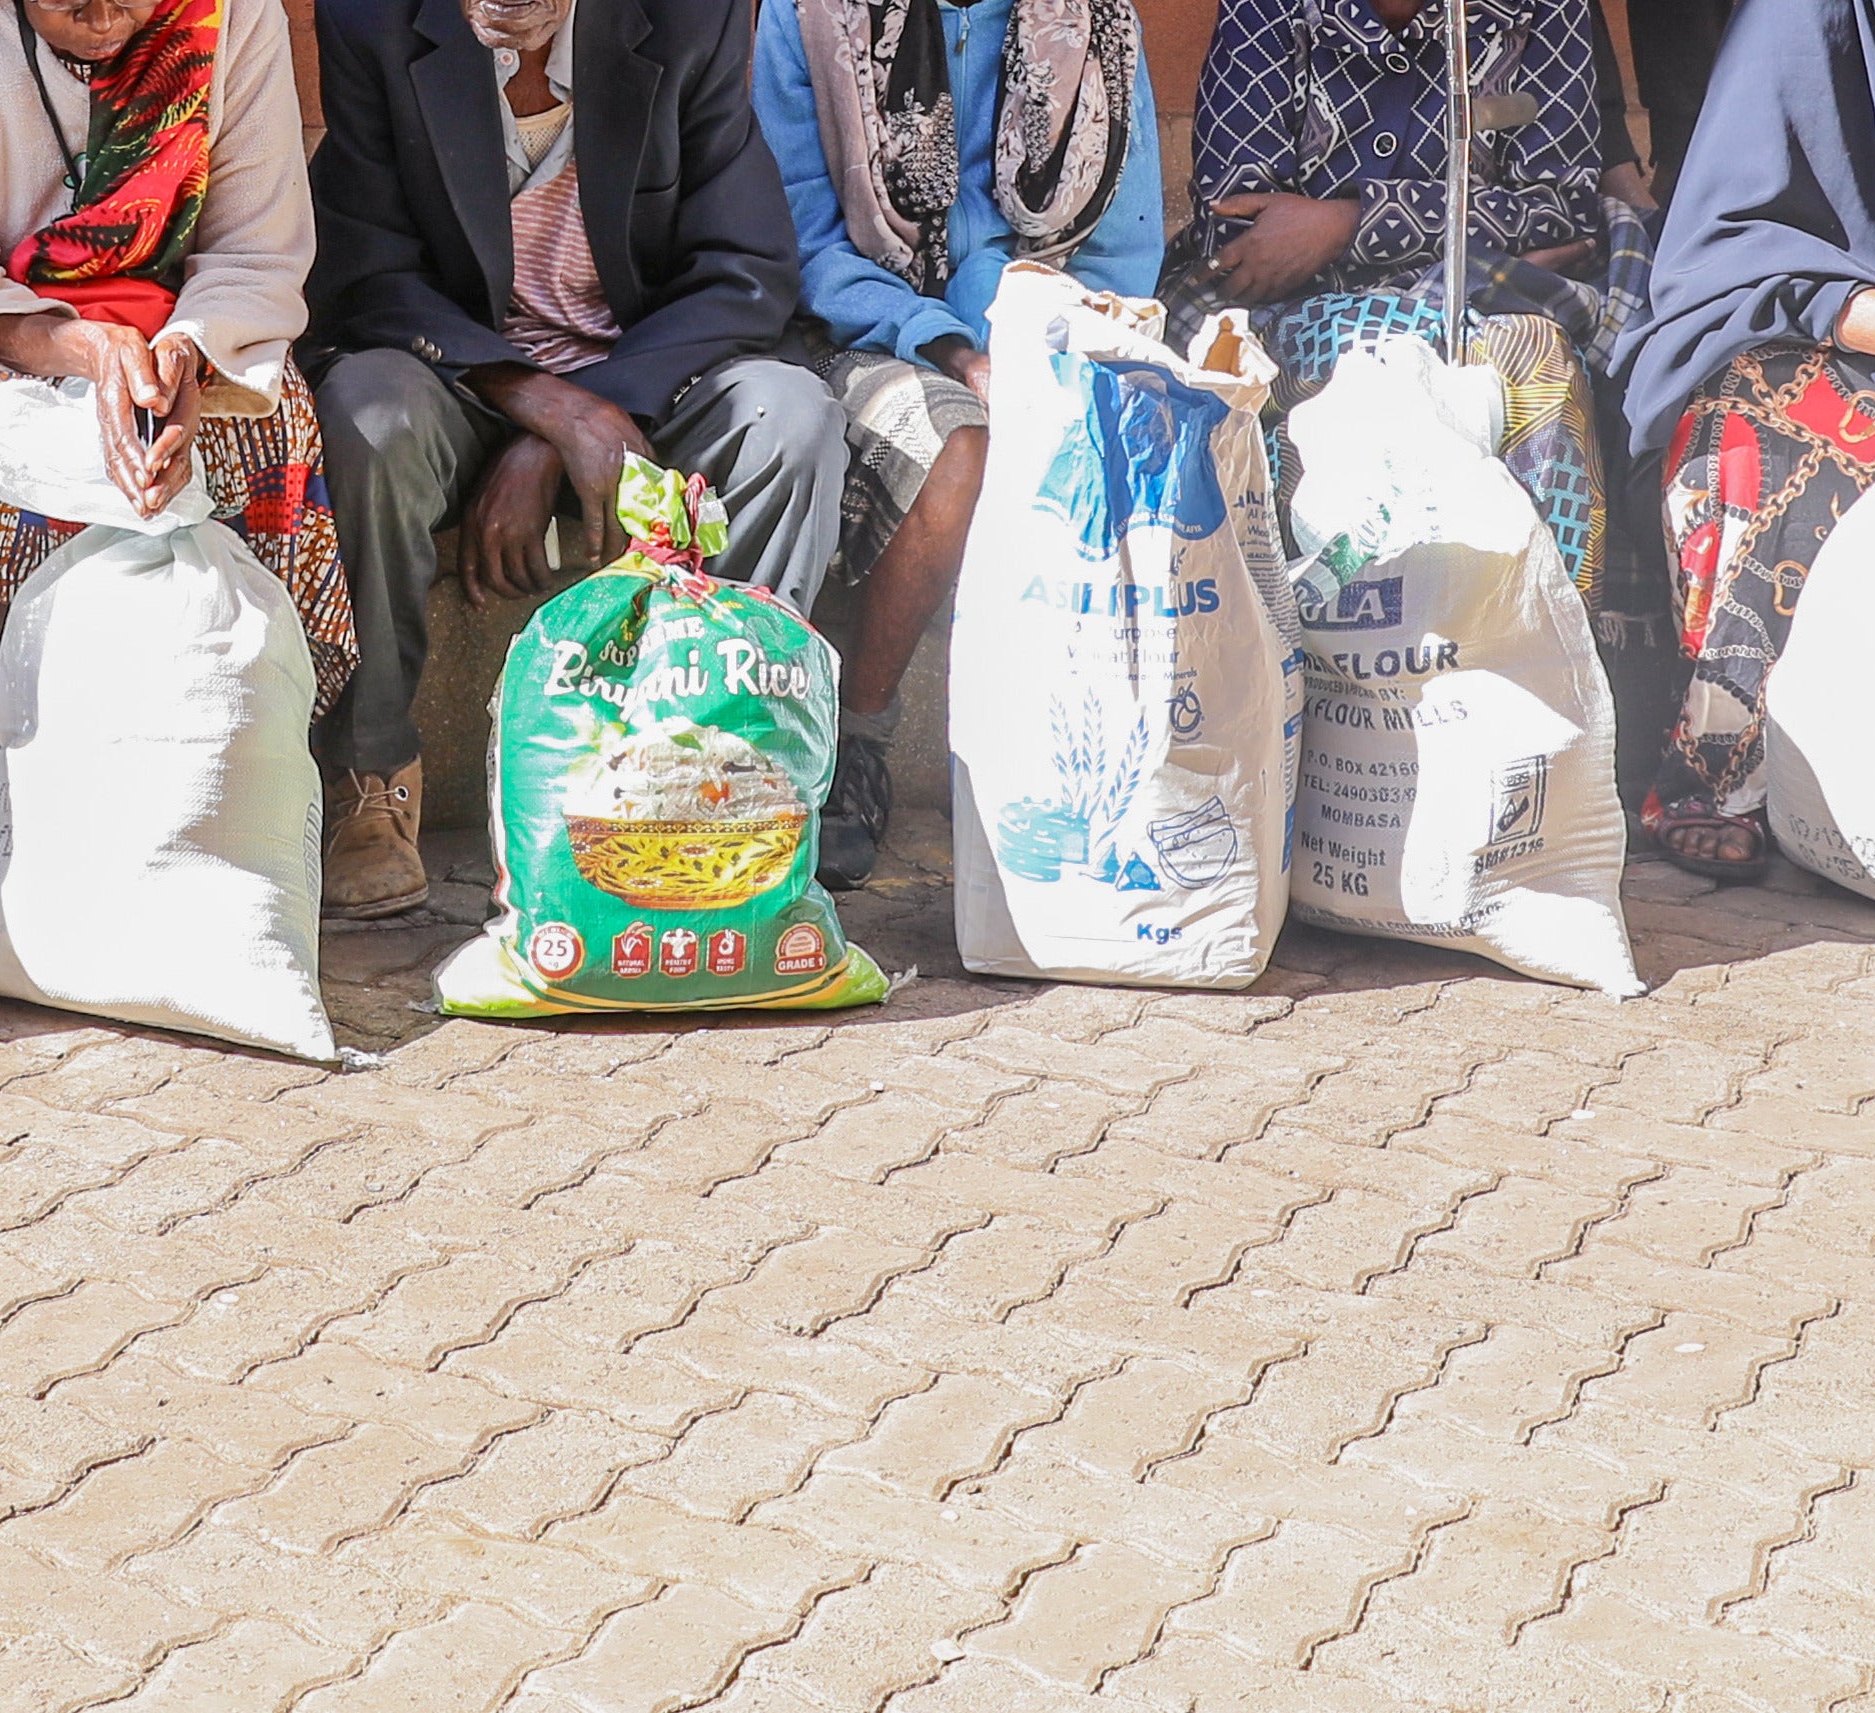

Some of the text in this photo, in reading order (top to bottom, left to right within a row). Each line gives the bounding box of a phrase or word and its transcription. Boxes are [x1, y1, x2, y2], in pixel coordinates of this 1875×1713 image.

[716, 637, 812, 699] Rice
[1332, 641, 1460, 680] FLOUR
[1378, 687, 1406, 702] BY:
[1314, 698, 1469, 731] FLOUR MILLS
[1336, 760, 1364, 776] BOX
[1303, 774, 1330, 792] TEL:
[1321, 804, 1402, 829] MOMBASA
[1301, 832, 1386, 870] Net Weight
[1312, 861, 1369, 897] 25 KG
[1136, 923, 1182, 945] Kgs
[543, 939, 567, 957] 25
[778, 956, 824, 971] GRADE 1
